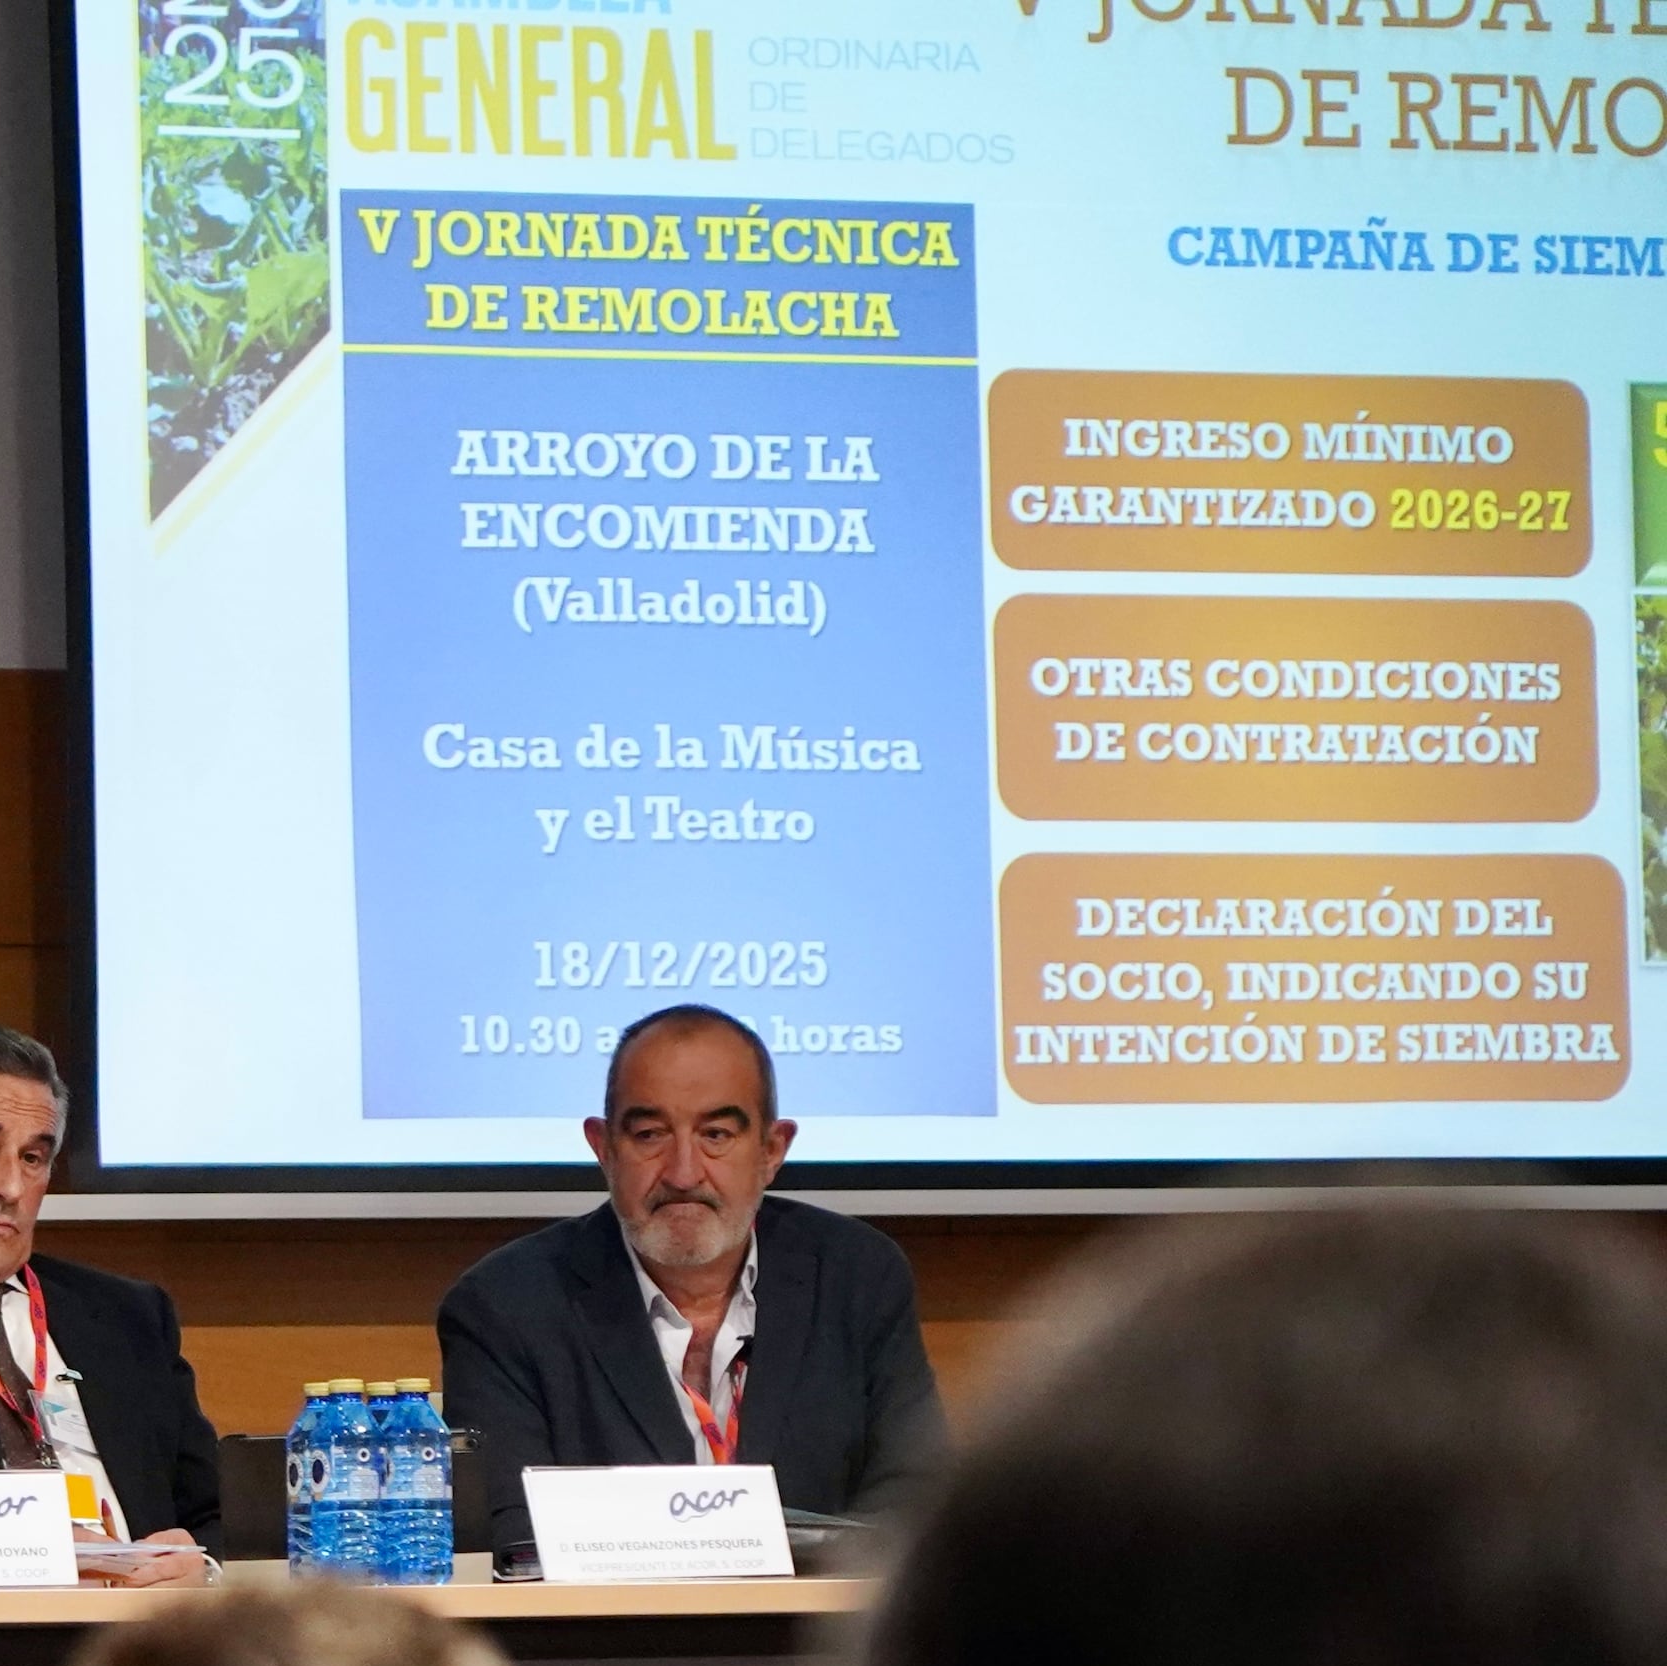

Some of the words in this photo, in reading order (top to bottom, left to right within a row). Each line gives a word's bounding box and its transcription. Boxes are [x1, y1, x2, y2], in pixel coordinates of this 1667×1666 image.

[163, 23, 304, 109] 25
[748, 36, 980, 74] ORDINARIA
[345, 18, 737, 162] GENERAL
[750, 80, 805, 113] DE
[1225, 67, 1361, 148] DE
[750, 127, 1015, 166] DELEGADOS
[359, 208, 399, 255] V
[411, 211, 689, 268] JORNADA
[697, 205, 959, 267] TÉCNICA
[1167, 216, 1434, 272] CAMPAÑA
[1446, 233, 1519, 273] DE
[426, 284, 508, 330] DE
[522, 287, 900, 339] REMOLACHA
[451, 430, 697, 480] ARROYO
[710, 434, 792, 481] DE
[805, 436, 880, 483] LA
[1065, 419, 1291, 461] INGRESO
[1304, 411, 1514, 465] MÍNIMO
[462, 503, 875, 555] ENCOMIENDA
[1011, 486, 1376, 530] GARANTIZADO
[1389, 489, 1571, 532] 2026-27
[513, 576, 826, 636] (Valladolid)
[1031, 657, 1192, 699] OTRAS
[1206, 659, 1561, 701] CONDICIONES
[422, 722, 561, 770] Casa
[576, 724, 642, 770] de
[654, 724, 707, 770] la
[720, 725, 921, 772] Música
[1055, 722, 1125, 761] DE
[1138, 712, 1539, 764] CONTRATACIÓN
[536, 807, 568, 853] y
[584, 796, 633, 841] el
[646, 796, 815, 842] Teatro
[1076, 886, 1442, 937] DECLARACIÓN
[1454, 898, 1553, 936] DEL
[534, 941, 828, 988] 18/12/2025
[1043, 961, 1214, 1011] SOCIO,
[1227, 961, 1521, 1001] INDICANDO
[1534, 961, 1589, 1000] SU
[460, 1015, 581, 1054] 10.30
[770, 1016, 902, 1052] horas
[1014, 1012, 1307, 1065] INTENCIÓN
[1318, 1024, 1386, 1063] DE
[1398, 1023, 1620, 1063] SIEMBRA
[669, 1488, 749, 1519] acor
[574, 1541, 616, 1553] ELISEO
[700, 1538, 763, 1550] PESQUERA
